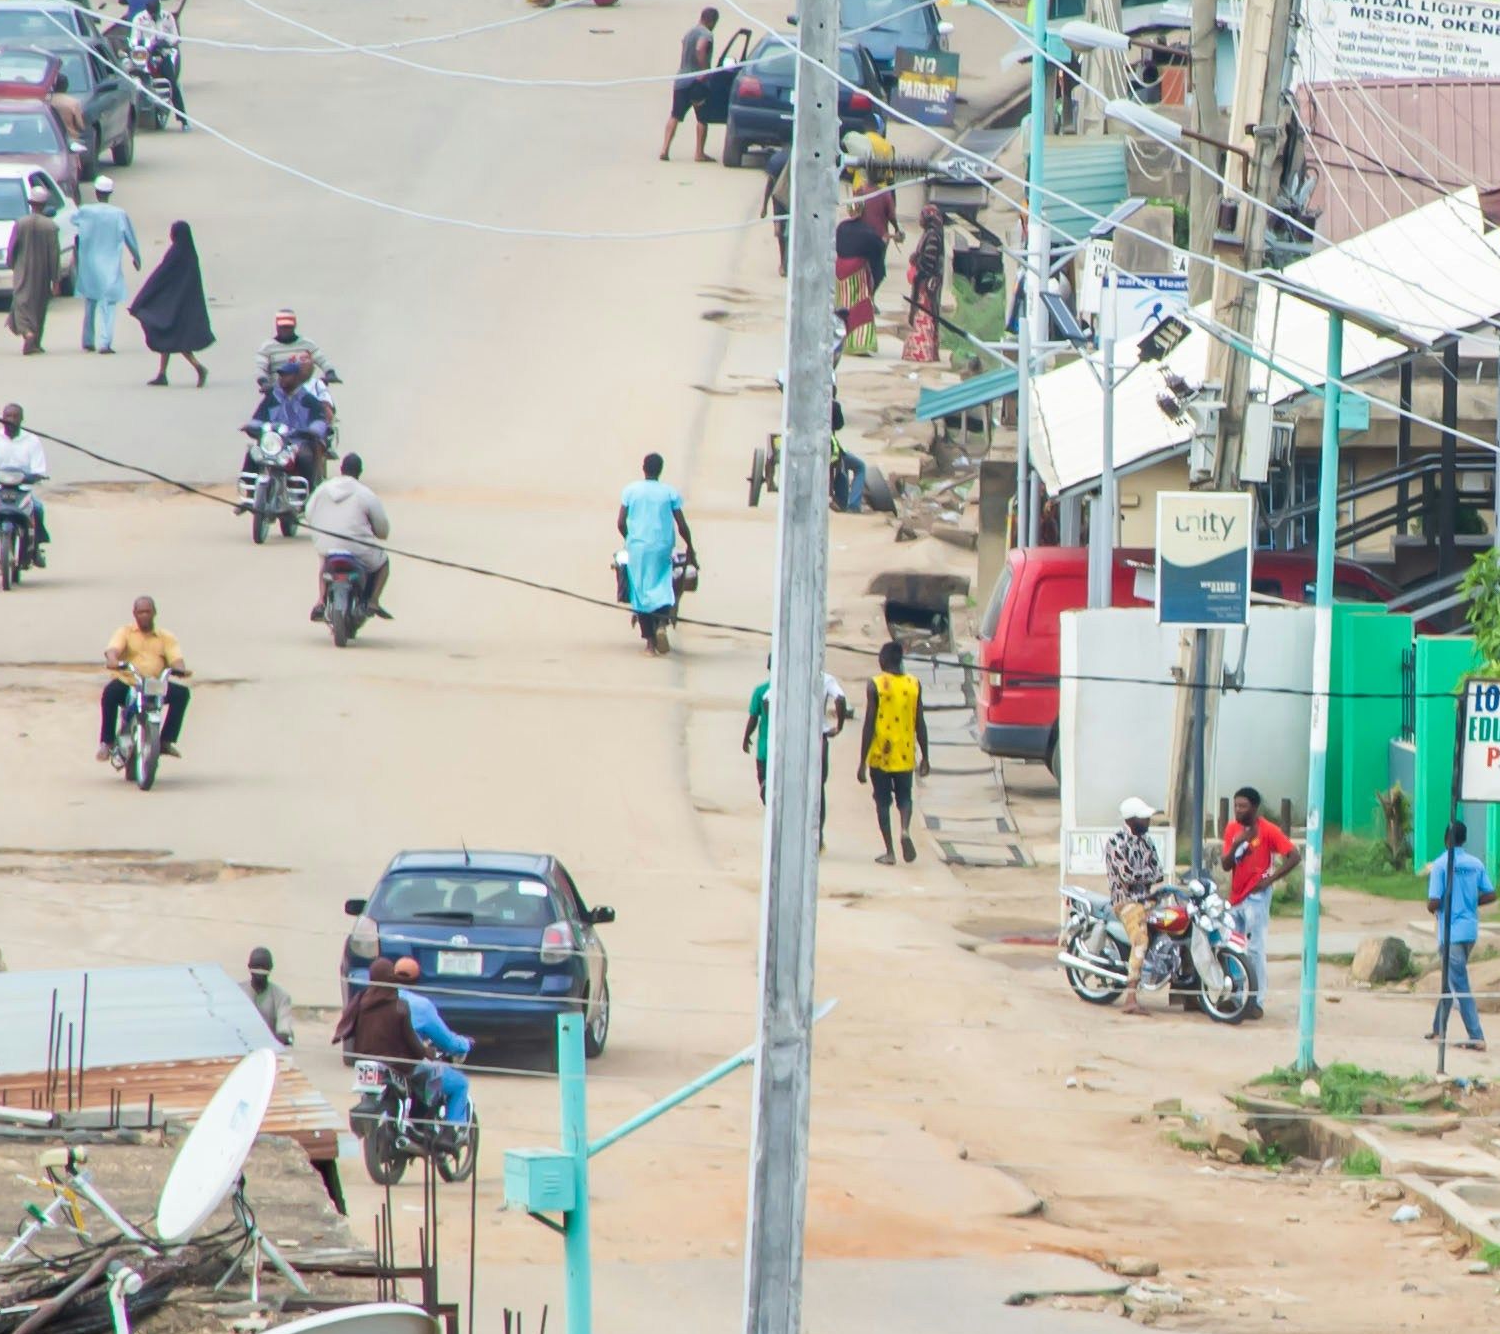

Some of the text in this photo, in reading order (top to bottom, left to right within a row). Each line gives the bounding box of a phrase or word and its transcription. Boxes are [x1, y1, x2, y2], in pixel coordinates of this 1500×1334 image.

[1350, 5, 1436, 30] MISSION,
[1420, 0, 1476, 17] LIGHT
[1360, 30, 1385, 43] Sunday
[913, 55, 937, 74] NO
[1417, 50, 1442, 65] Sunday
[898, 78, 950, 103] PARKING
[1175, 509, 1236, 542] unity
